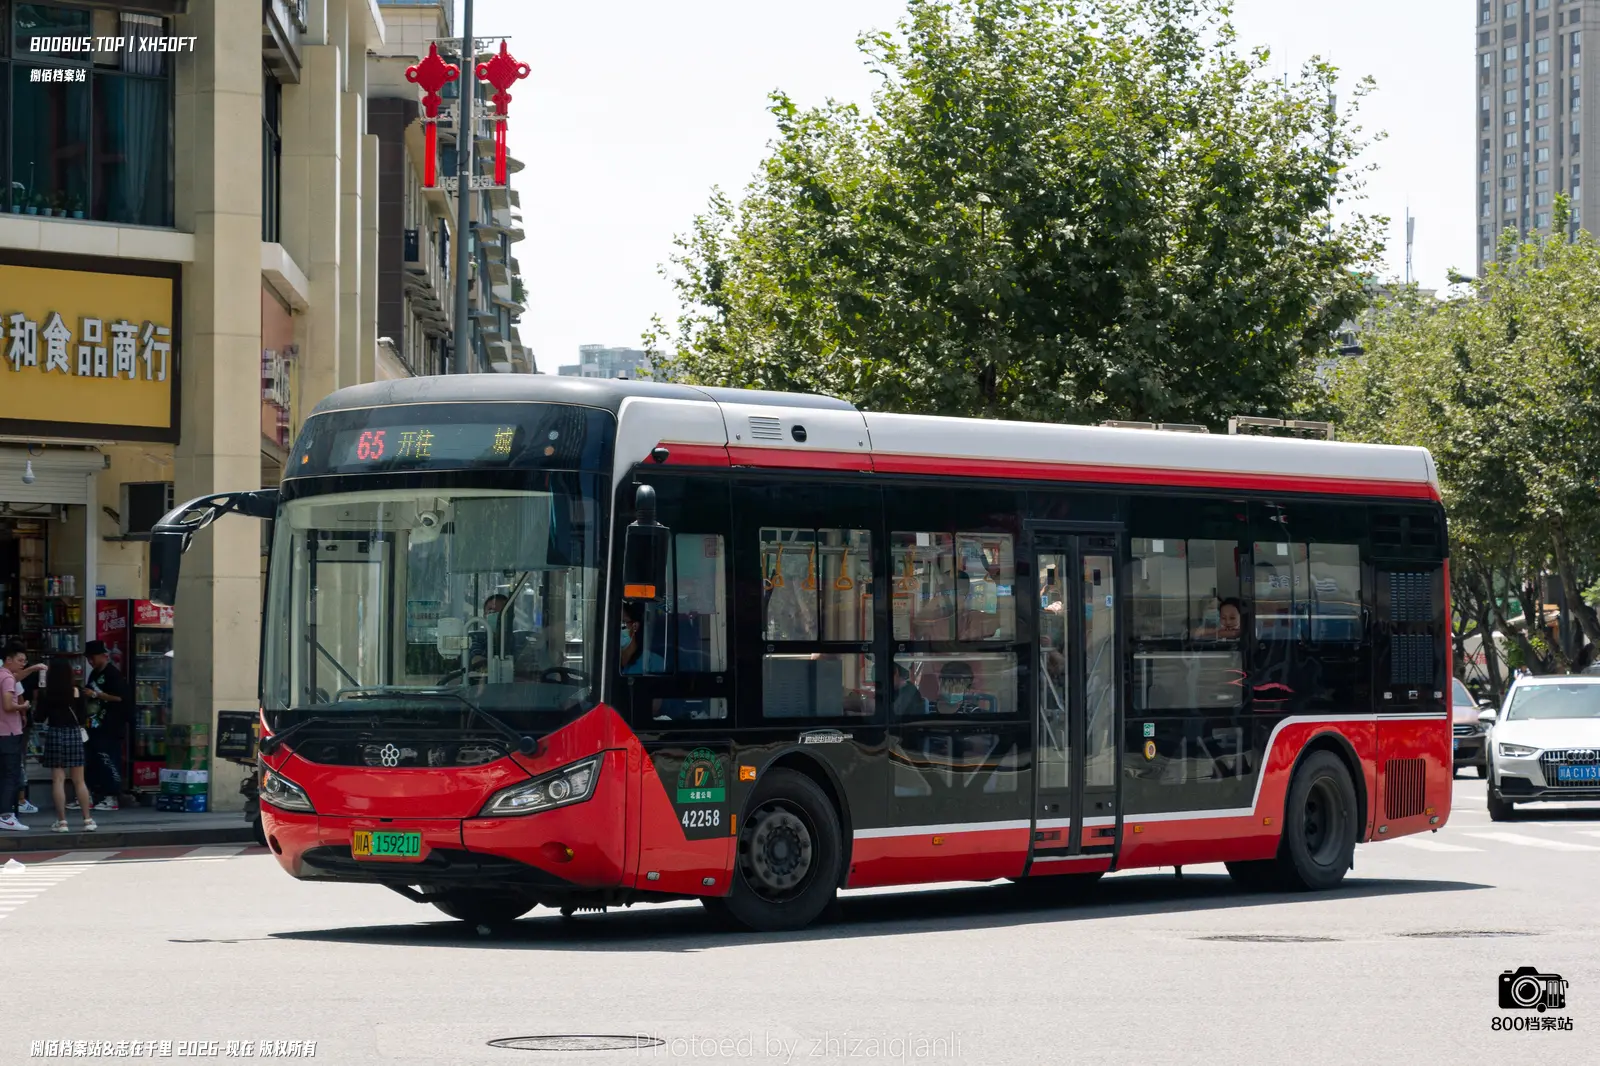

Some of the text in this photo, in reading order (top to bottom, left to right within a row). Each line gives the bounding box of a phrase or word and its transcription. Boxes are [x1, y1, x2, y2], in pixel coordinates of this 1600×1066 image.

[0, 312, 170, 381] 和食品商行
[357, 430, 385, 460] 65
[396, 429, 435, 458] 开往
[682, 809, 720, 827] 42258
[376, 836, 419, 853] 15921D
